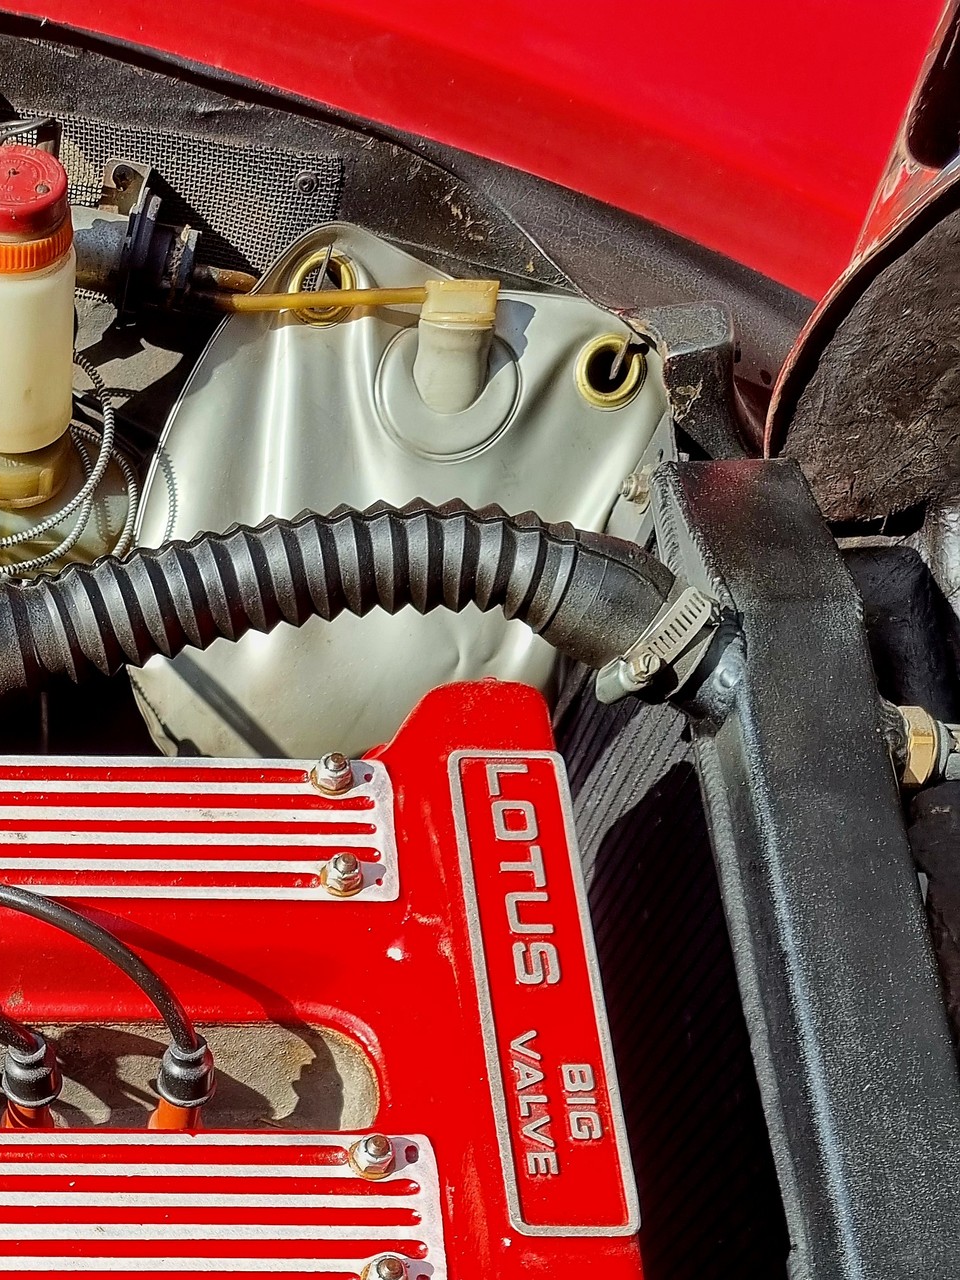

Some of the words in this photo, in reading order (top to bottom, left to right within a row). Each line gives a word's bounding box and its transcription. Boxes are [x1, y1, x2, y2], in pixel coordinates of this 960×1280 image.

[486, 763, 561, 986] LOTUS
[510, 1030, 560, 1177] VALVE
[561, 1063, 603, 1141] BIG
